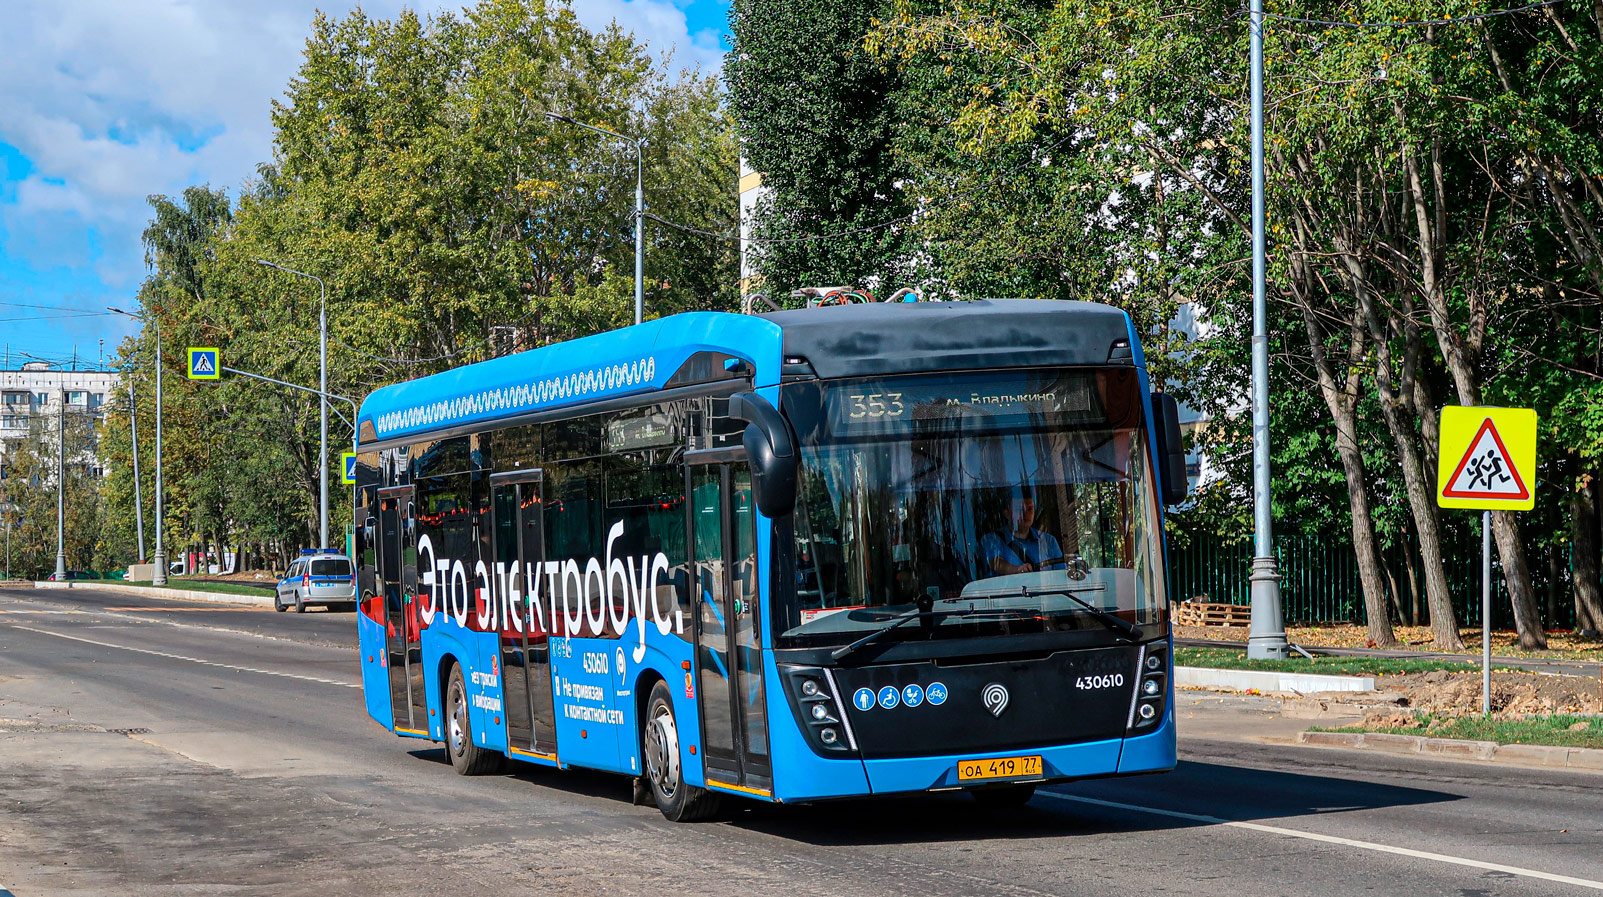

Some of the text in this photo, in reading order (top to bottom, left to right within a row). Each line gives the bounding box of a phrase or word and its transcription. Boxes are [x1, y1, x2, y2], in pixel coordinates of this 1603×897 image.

[849, 392, 903, 418] 353
[418, 519, 684, 664] Это электробус.
[583, 652, 609, 674] 430610
[562, 677, 604, 702] Не привязан
[1075, 673, 1124, 690] 430610
[568, 704, 607, 723] контактной
[607, 709, 624, 725] сети
[989, 760, 1015, 775] 419
[1023, 757, 1037, 769] 77
